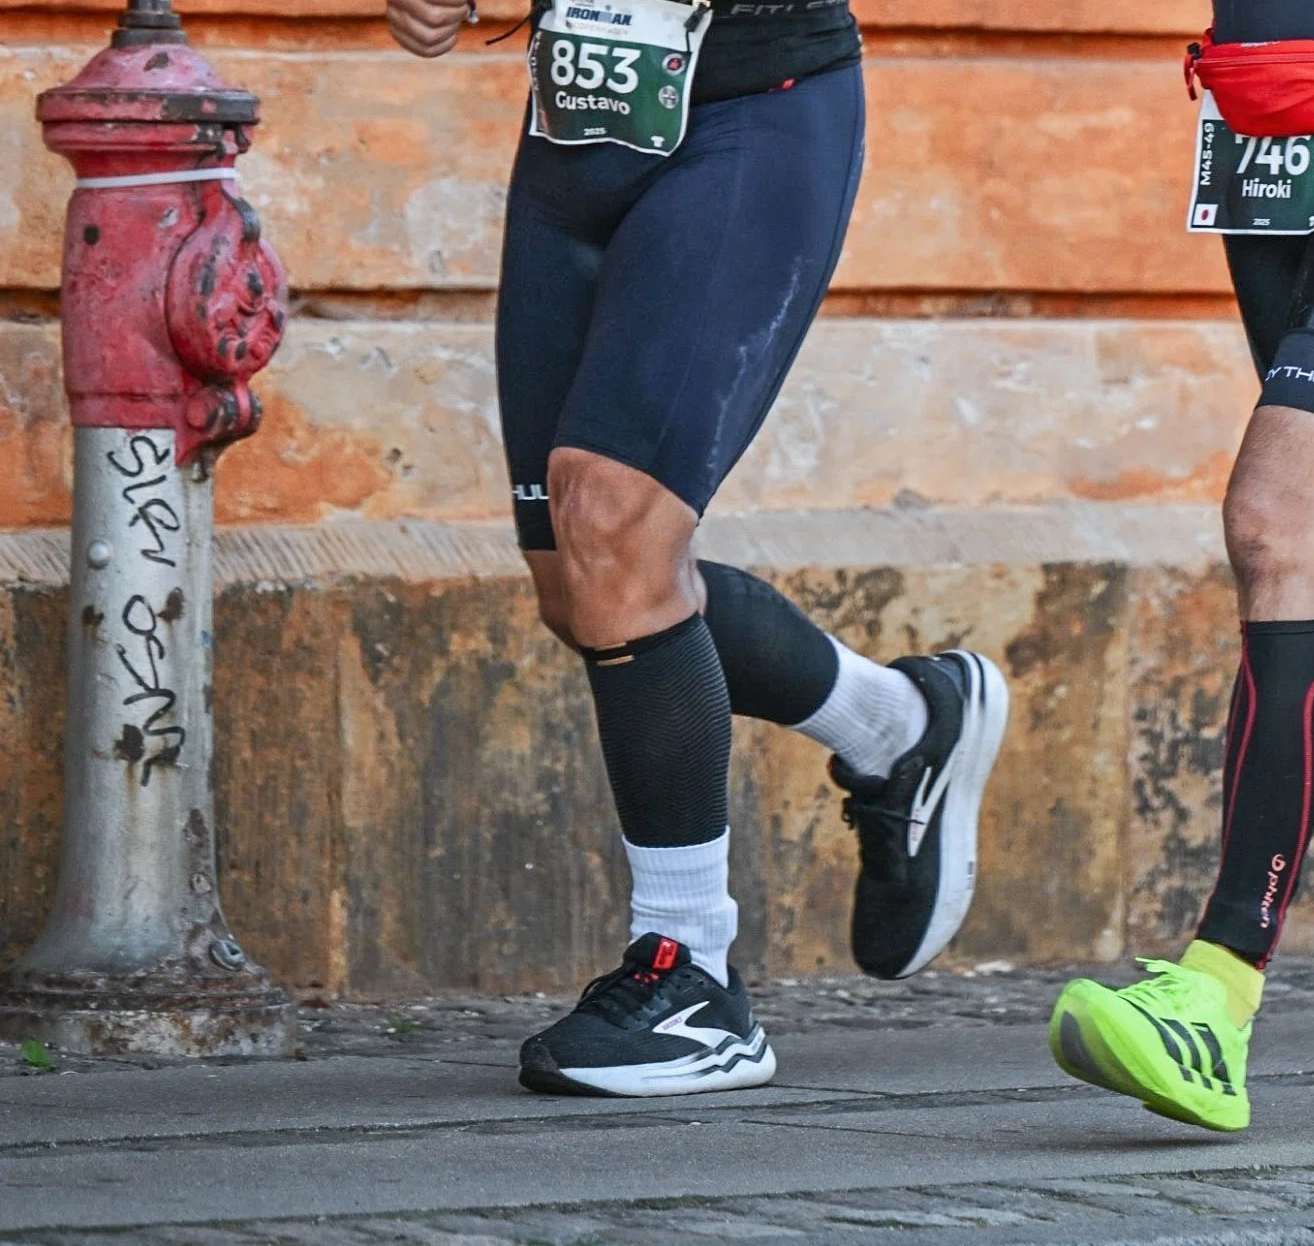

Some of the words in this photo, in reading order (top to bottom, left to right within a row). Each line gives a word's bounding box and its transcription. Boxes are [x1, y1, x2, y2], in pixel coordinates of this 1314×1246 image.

[551, 39, 642, 94] 853
[555, 90, 631, 115] Gustavo
[1200, 122, 1216, 186] M45-49
[1235, 135, 1311, 176] 746
[1242, 178, 1292, 199] Hiroki
